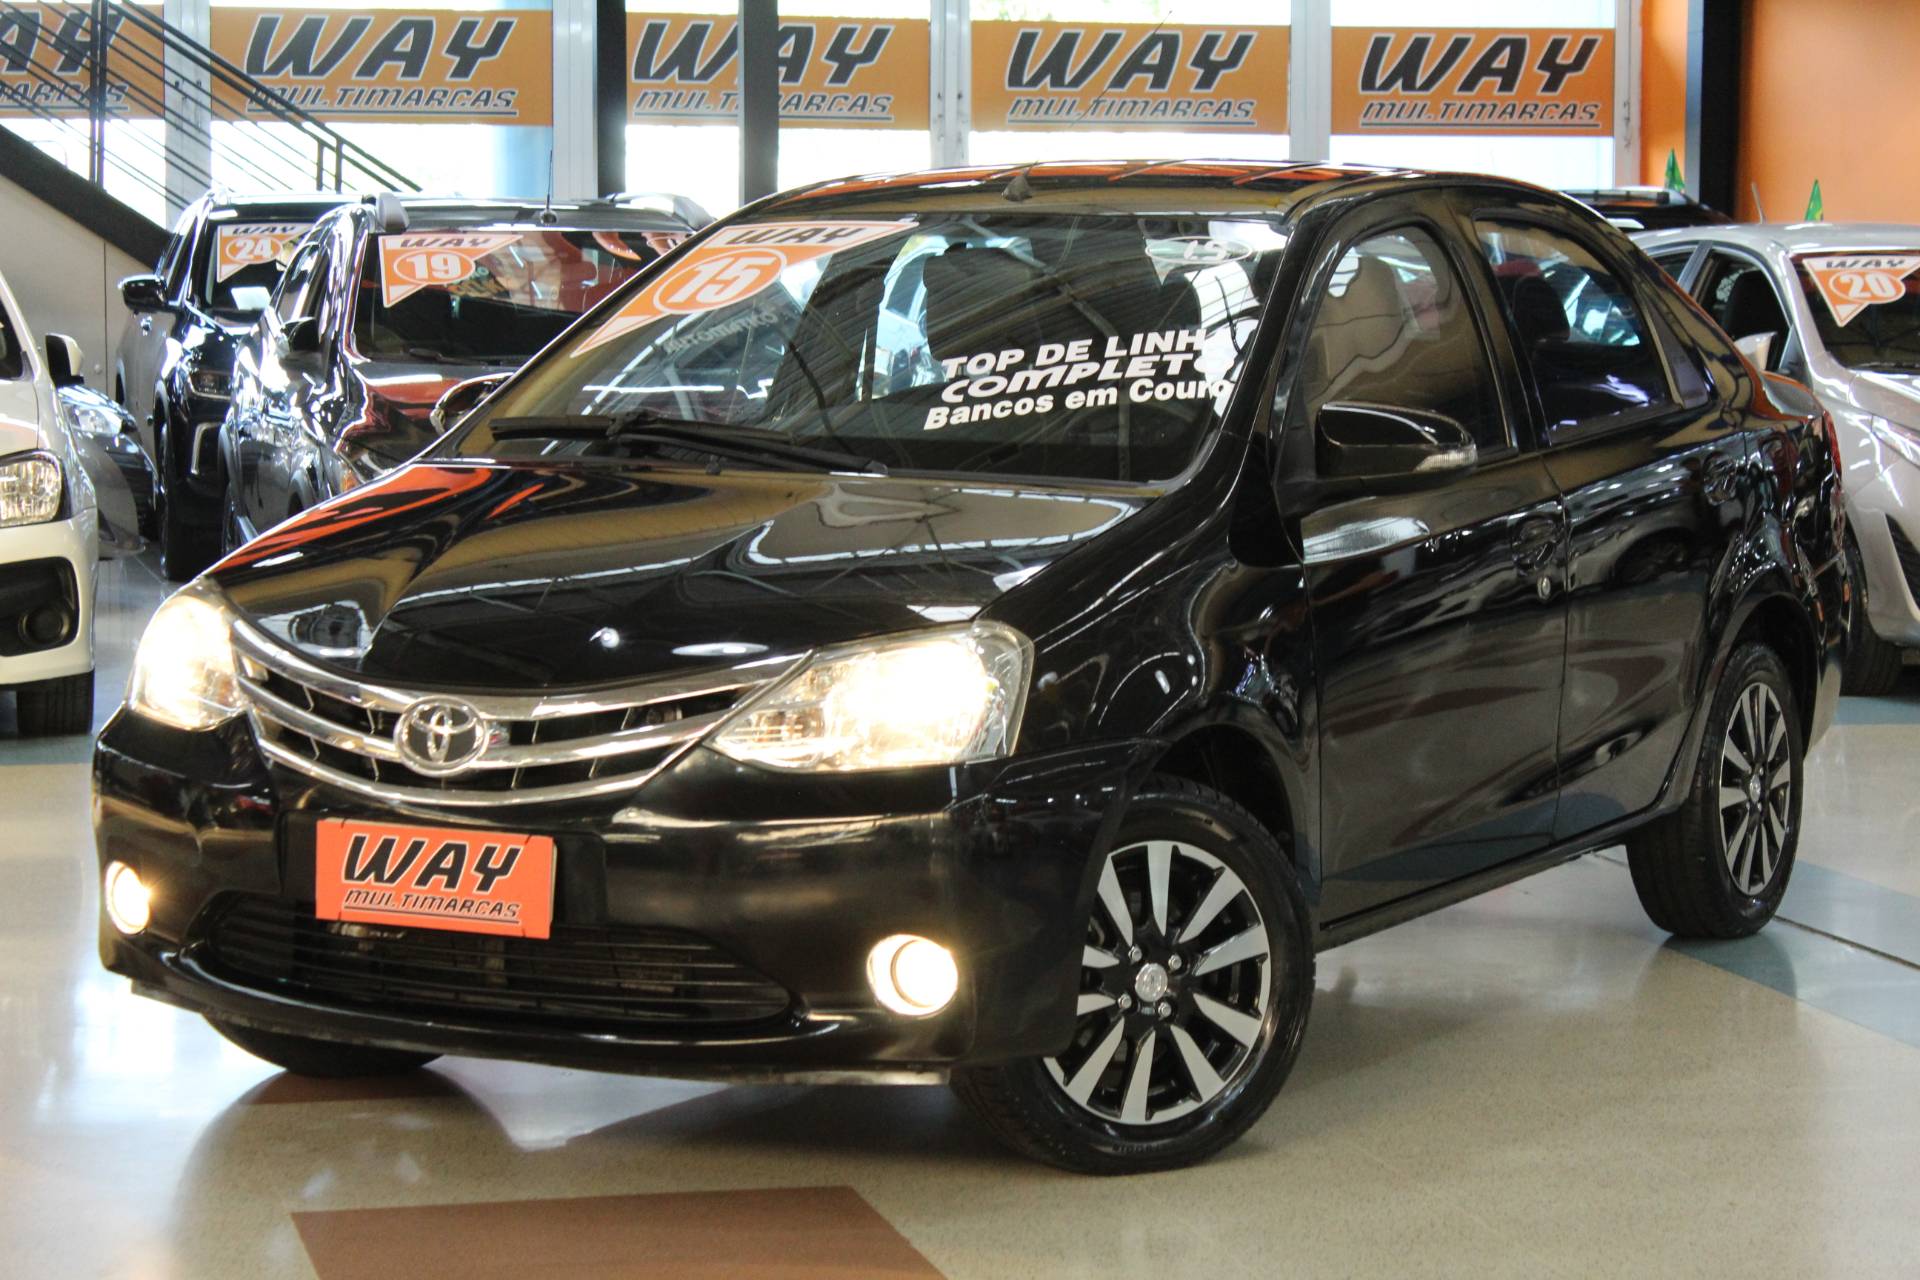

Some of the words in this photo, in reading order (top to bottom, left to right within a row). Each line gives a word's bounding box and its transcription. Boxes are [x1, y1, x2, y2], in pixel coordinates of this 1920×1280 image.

[0, 9, 126, 75] AY
[245, 15, 518, 82] WAY
[1006, 28, 1258, 92] WAY
[1359, 33, 1601, 96] WAY
[247, 86, 517, 109] MULTIMARCAS
[635, 91, 893, 113] MULTARCAS
[1009, 97, 1255, 119] MULTIMARCAS
[1361, 101, 1600, 122] MULTIMARCAS
[401, 237, 491, 248] WAY
[726, 226, 863, 244] WAY
[234, 238, 271, 260] 24
[405, 253, 462, 279] 19
[1825, 259, 1906, 269] WAY
[666, 256, 776, 304] 15
[1838, 273, 1897, 298] 20
[940, 348, 1025, 379] TOP
[1035, 339, 1093, 367] DE
[1104, 329, 1207, 359] LINH
[923, 394, 1055, 431] Bancos
[1065, 386, 1118, 410] em
[1129, 378, 1235, 403] Couro
[342, 833, 524, 893] WAY
[345, 889, 520, 918] MULTIMARCAS
